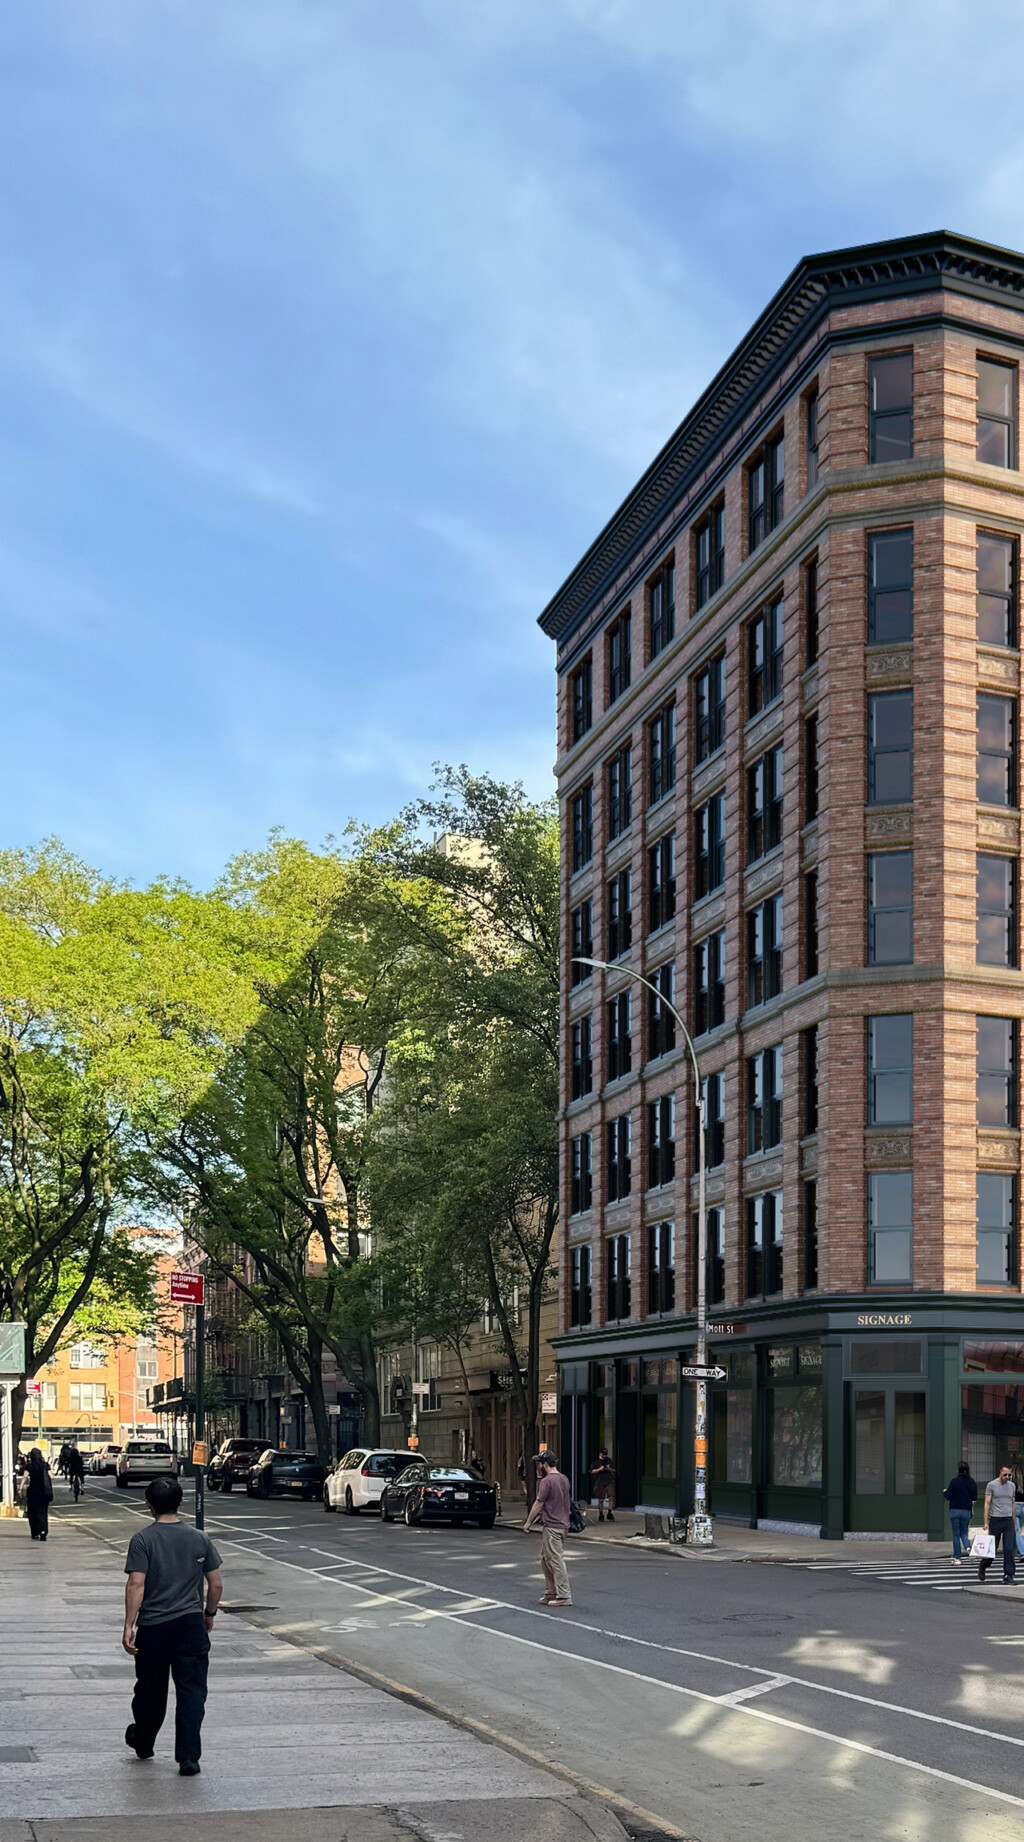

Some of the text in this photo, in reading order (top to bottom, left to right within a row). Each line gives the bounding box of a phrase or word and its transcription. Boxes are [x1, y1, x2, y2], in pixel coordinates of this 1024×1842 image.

[179, 1275, 199, 1284] STOPPING
[857, 1314, 912, 1325] SIGNAGE
[708, 1324, 734, 1334] Mott St
